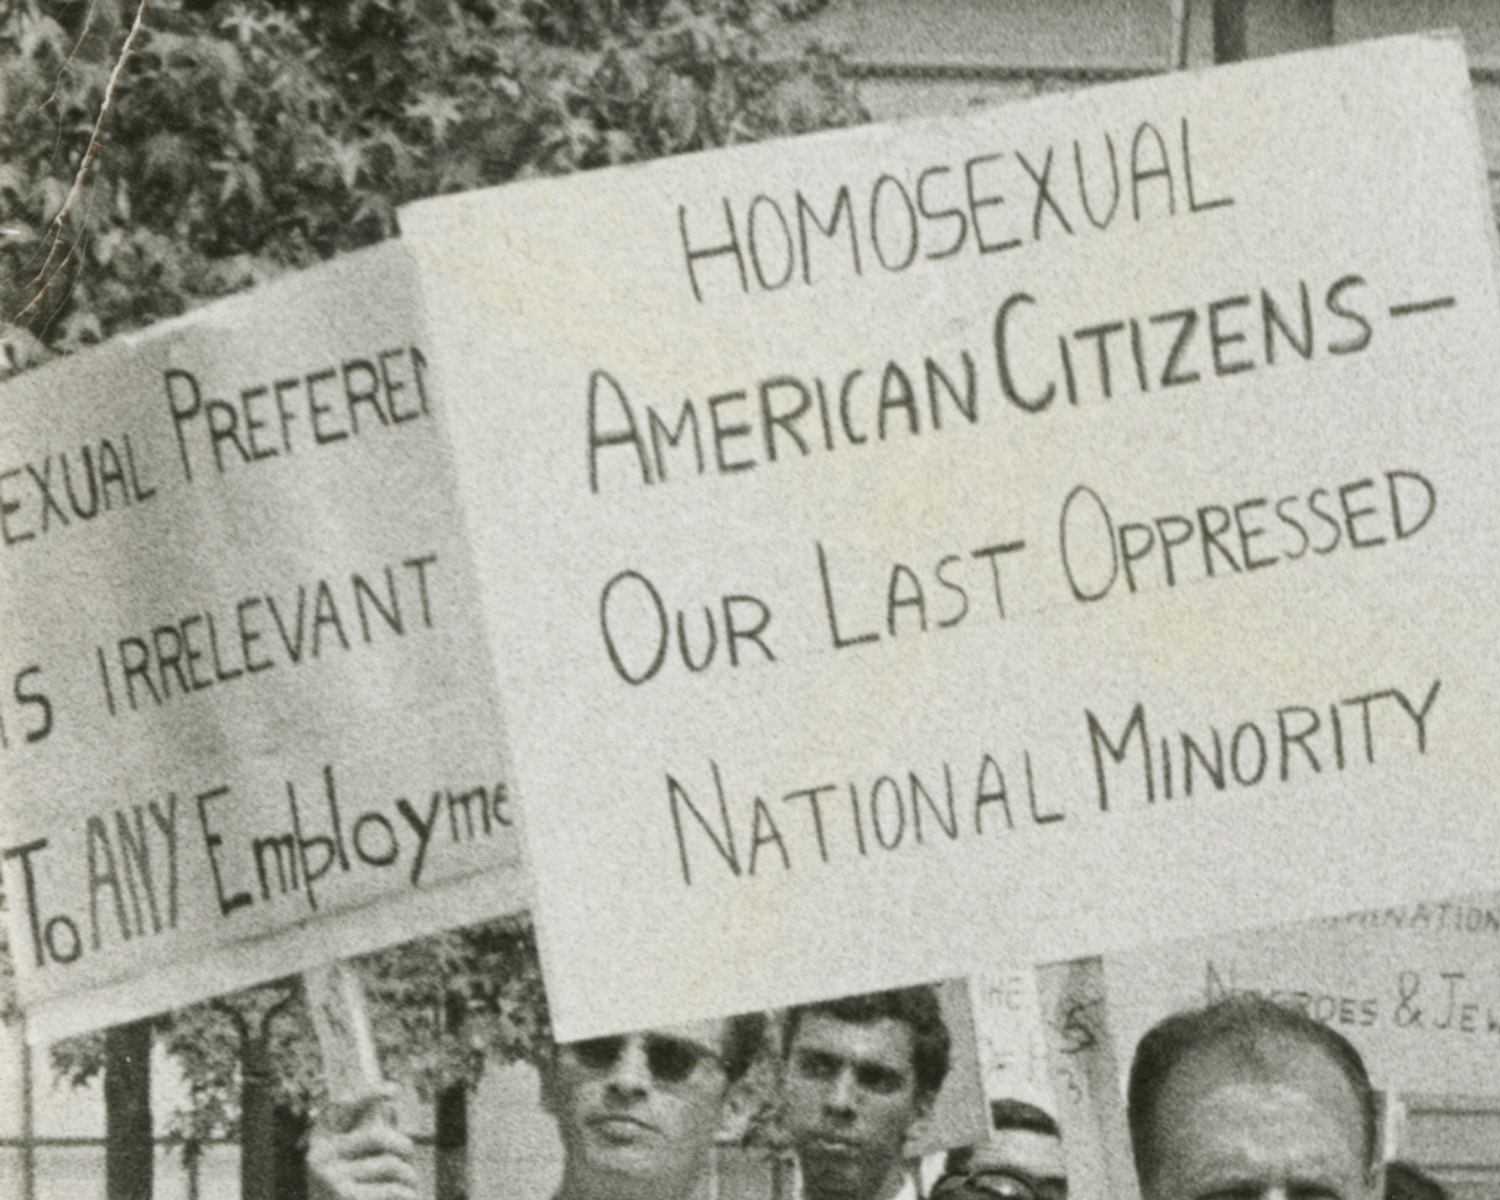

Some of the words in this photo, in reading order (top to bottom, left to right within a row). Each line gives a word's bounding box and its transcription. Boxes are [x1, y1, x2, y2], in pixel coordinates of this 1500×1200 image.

[678, 117, 1235, 302] HOMOSEXUAL
[587, 350, 978, 495] AMERICAN
[96, 554, 439, 718] IRRELEVANT
[600, 569, 776, 686] OUR
[815, 539, 1027, 650] LAST
[1058, 468, 1437, 604] OPPRESSED
[664, 749, 1065, 886] NATIONAL
[1082, 679, 1442, 812] MINORITY
[86, 790, 177, 952] ANY
[1393, 969, 1426, 1028] &
